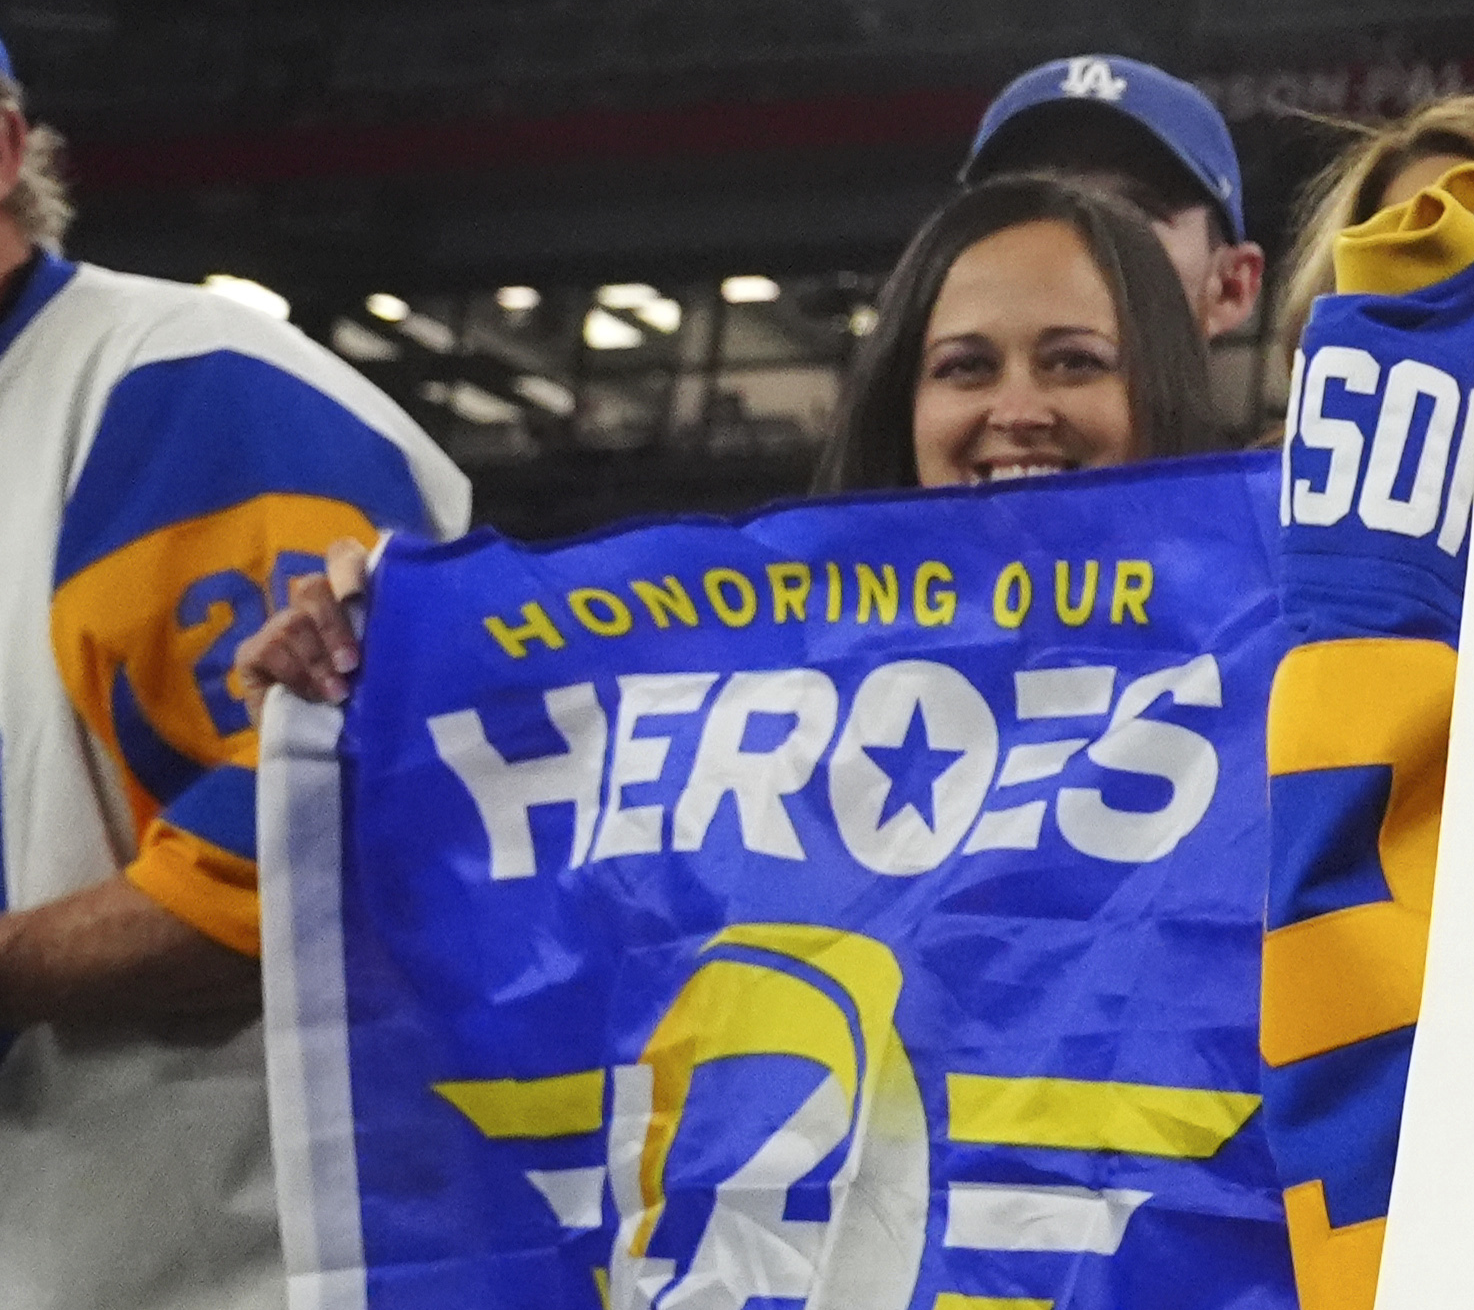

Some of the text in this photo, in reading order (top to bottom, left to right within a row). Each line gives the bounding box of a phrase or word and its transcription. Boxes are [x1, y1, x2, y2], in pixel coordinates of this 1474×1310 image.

[484, 559, 1154, 659] HONORING OUR
[426, 652, 1223, 881] HEROES
